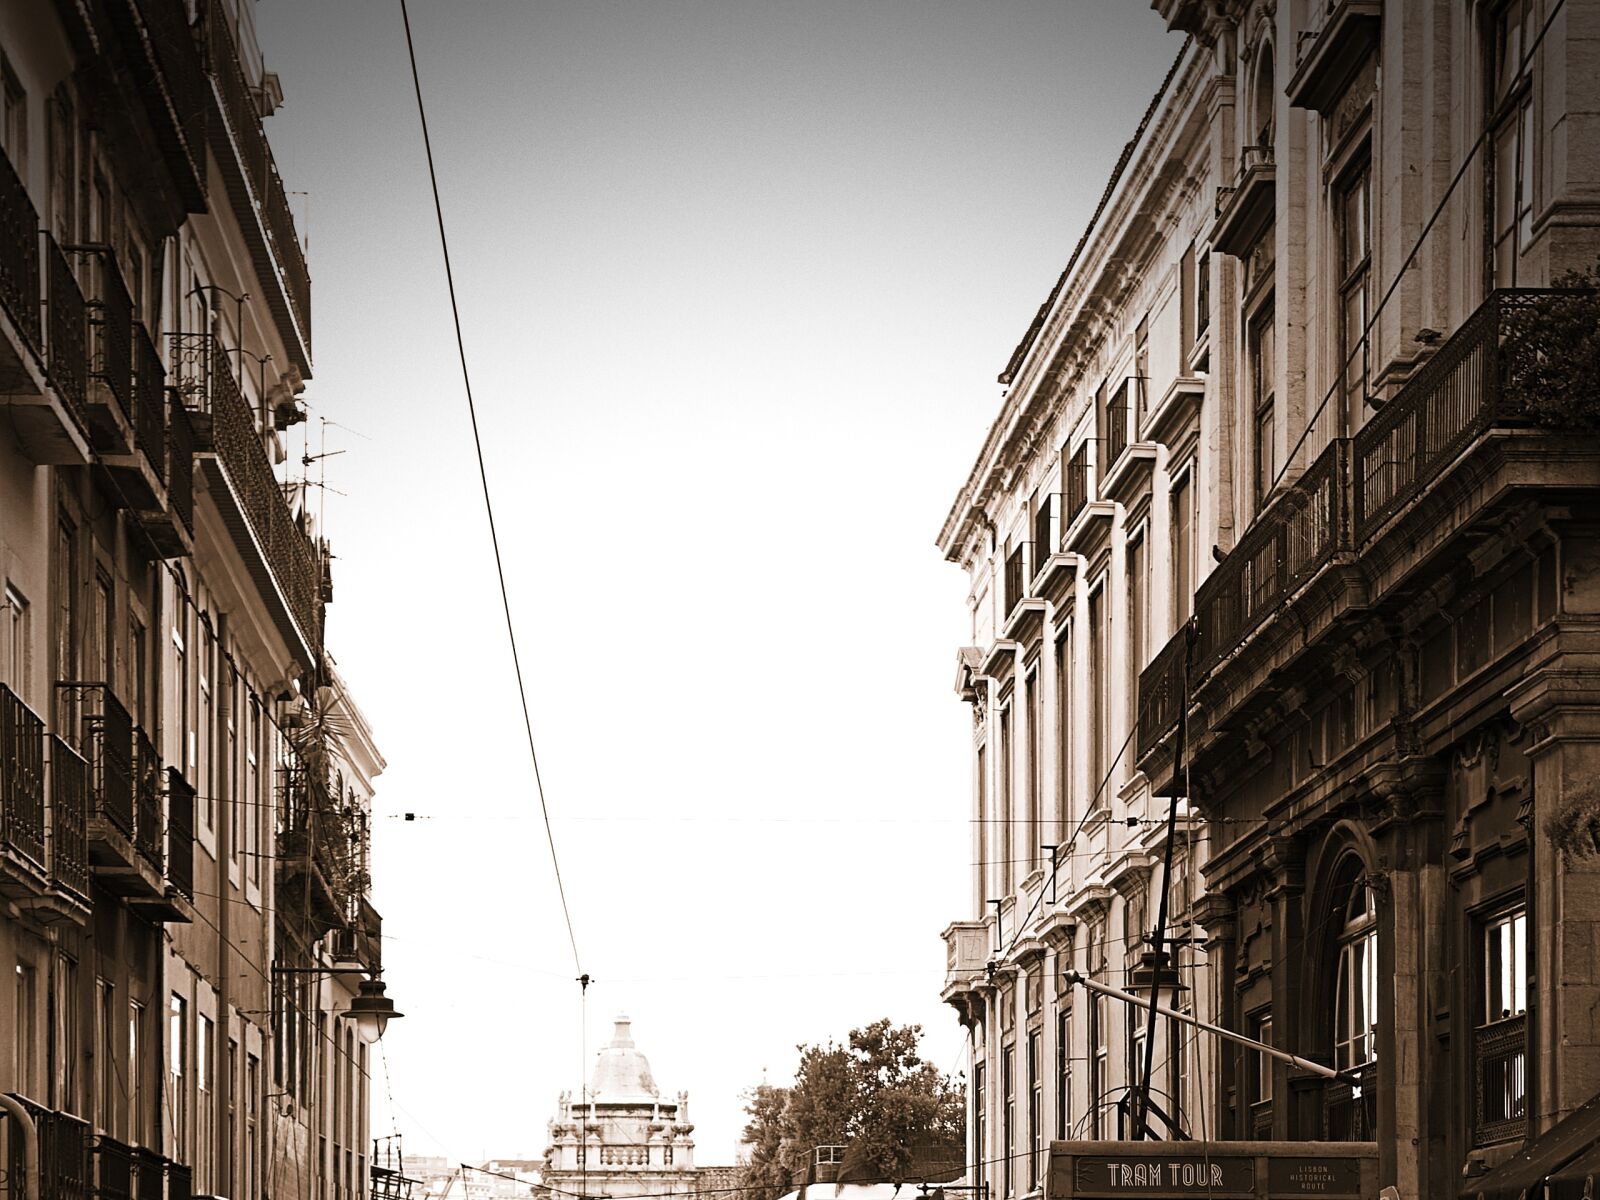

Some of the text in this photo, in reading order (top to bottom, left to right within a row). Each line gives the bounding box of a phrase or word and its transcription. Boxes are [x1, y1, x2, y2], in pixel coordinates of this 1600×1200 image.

[1107, 1163, 1223, 1187] TRAM TOUR
[1289, 1174, 1337, 1182] HISTORICAL
[1301, 1182, 1326, 1190] ROUTE
